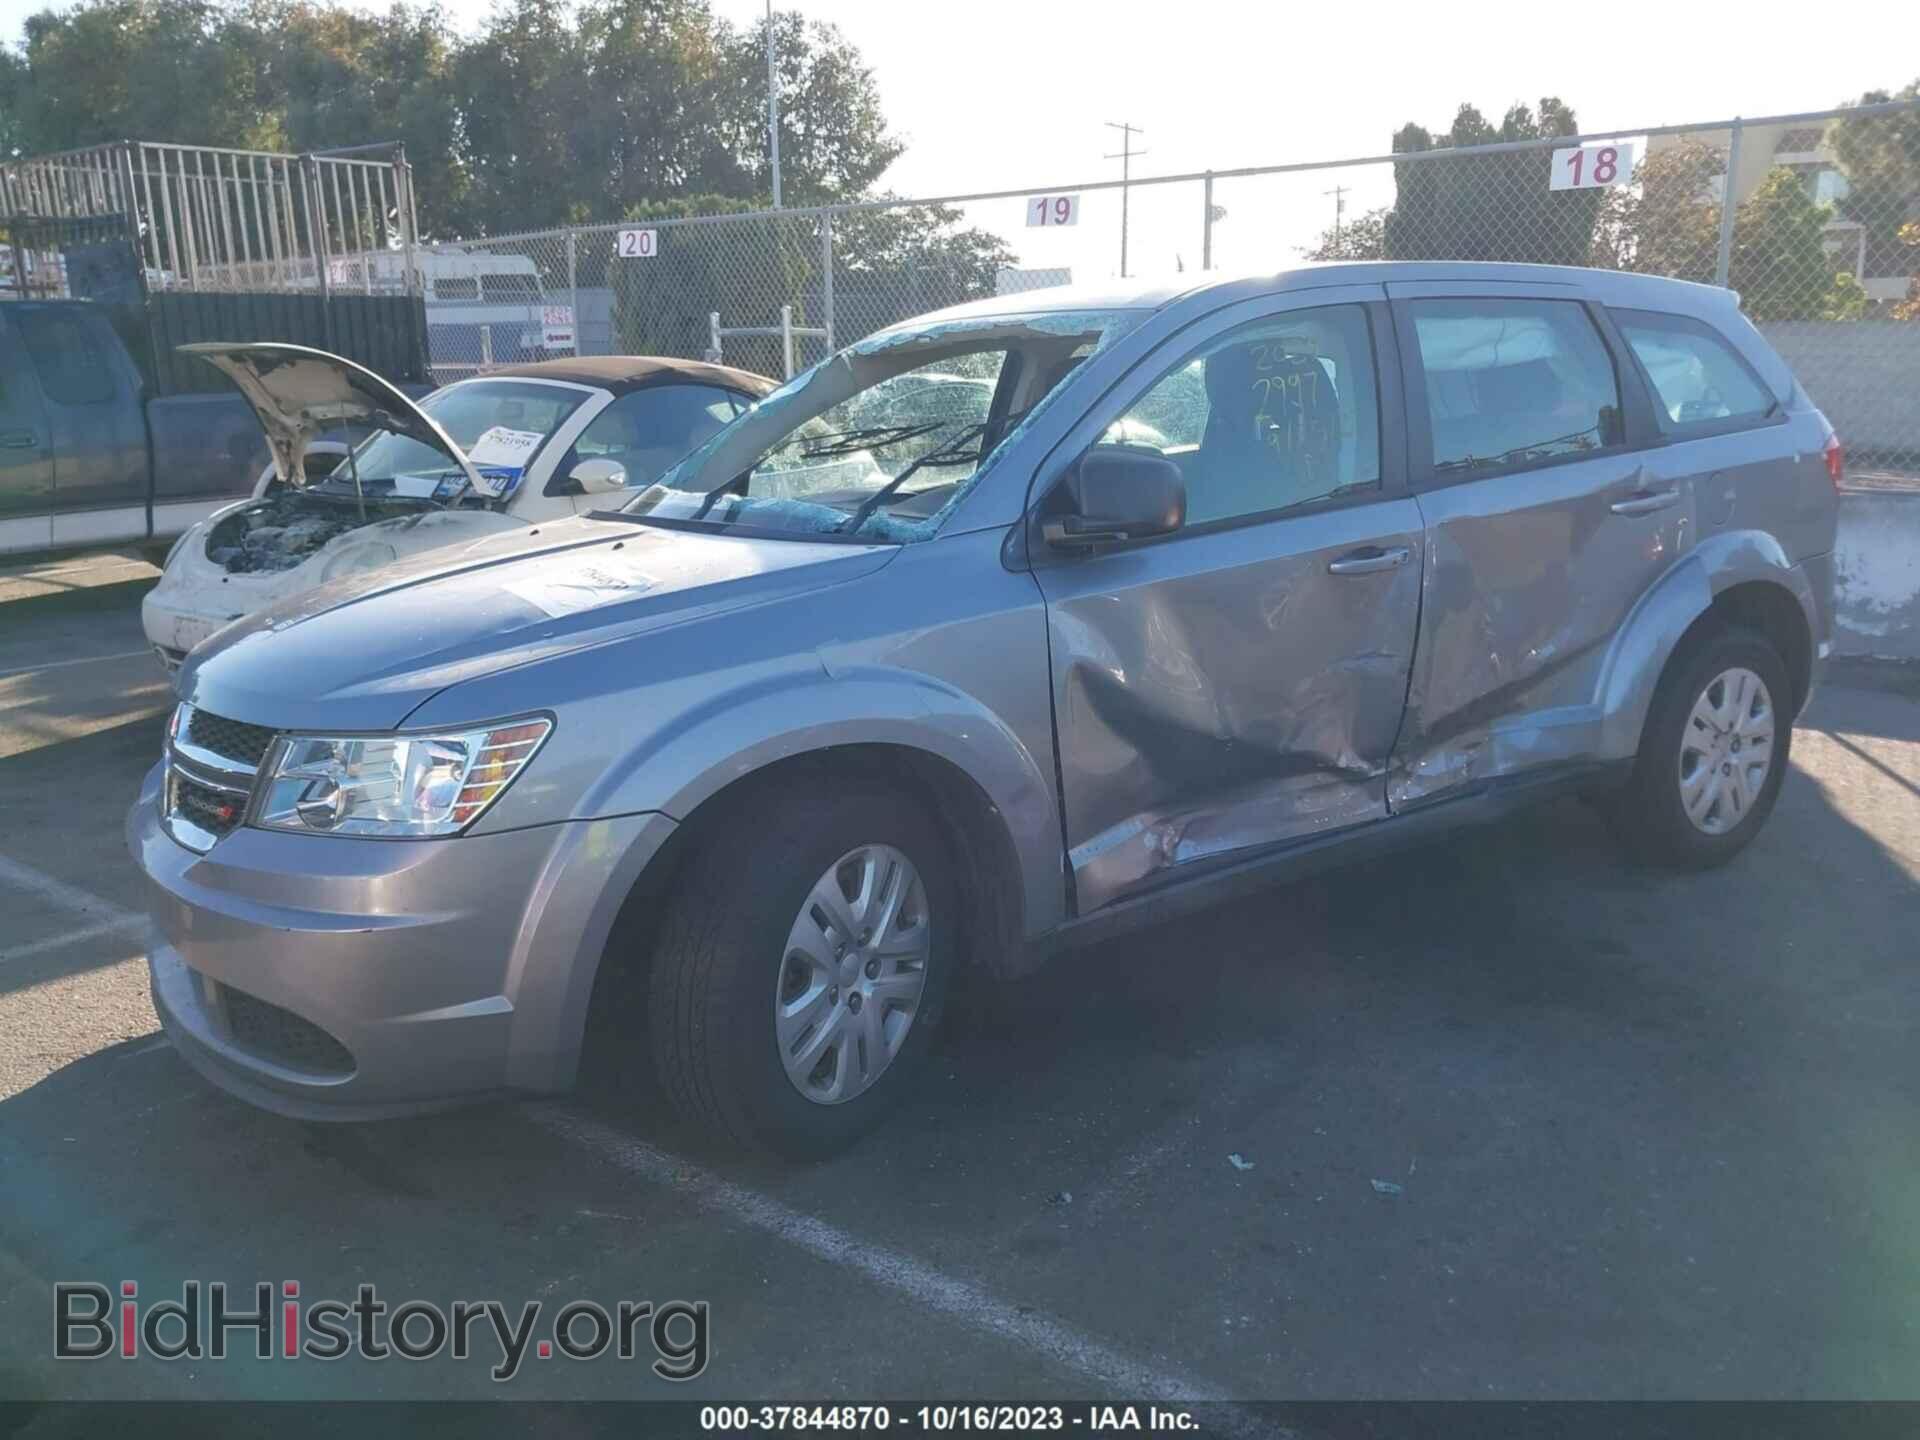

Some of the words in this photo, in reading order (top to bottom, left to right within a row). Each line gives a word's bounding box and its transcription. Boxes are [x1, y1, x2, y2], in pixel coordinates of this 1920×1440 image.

[1567, 147, 1618, 186] 18
[1036, 197, 1071, 226] 19
[625, 232, 651, 255] 20
